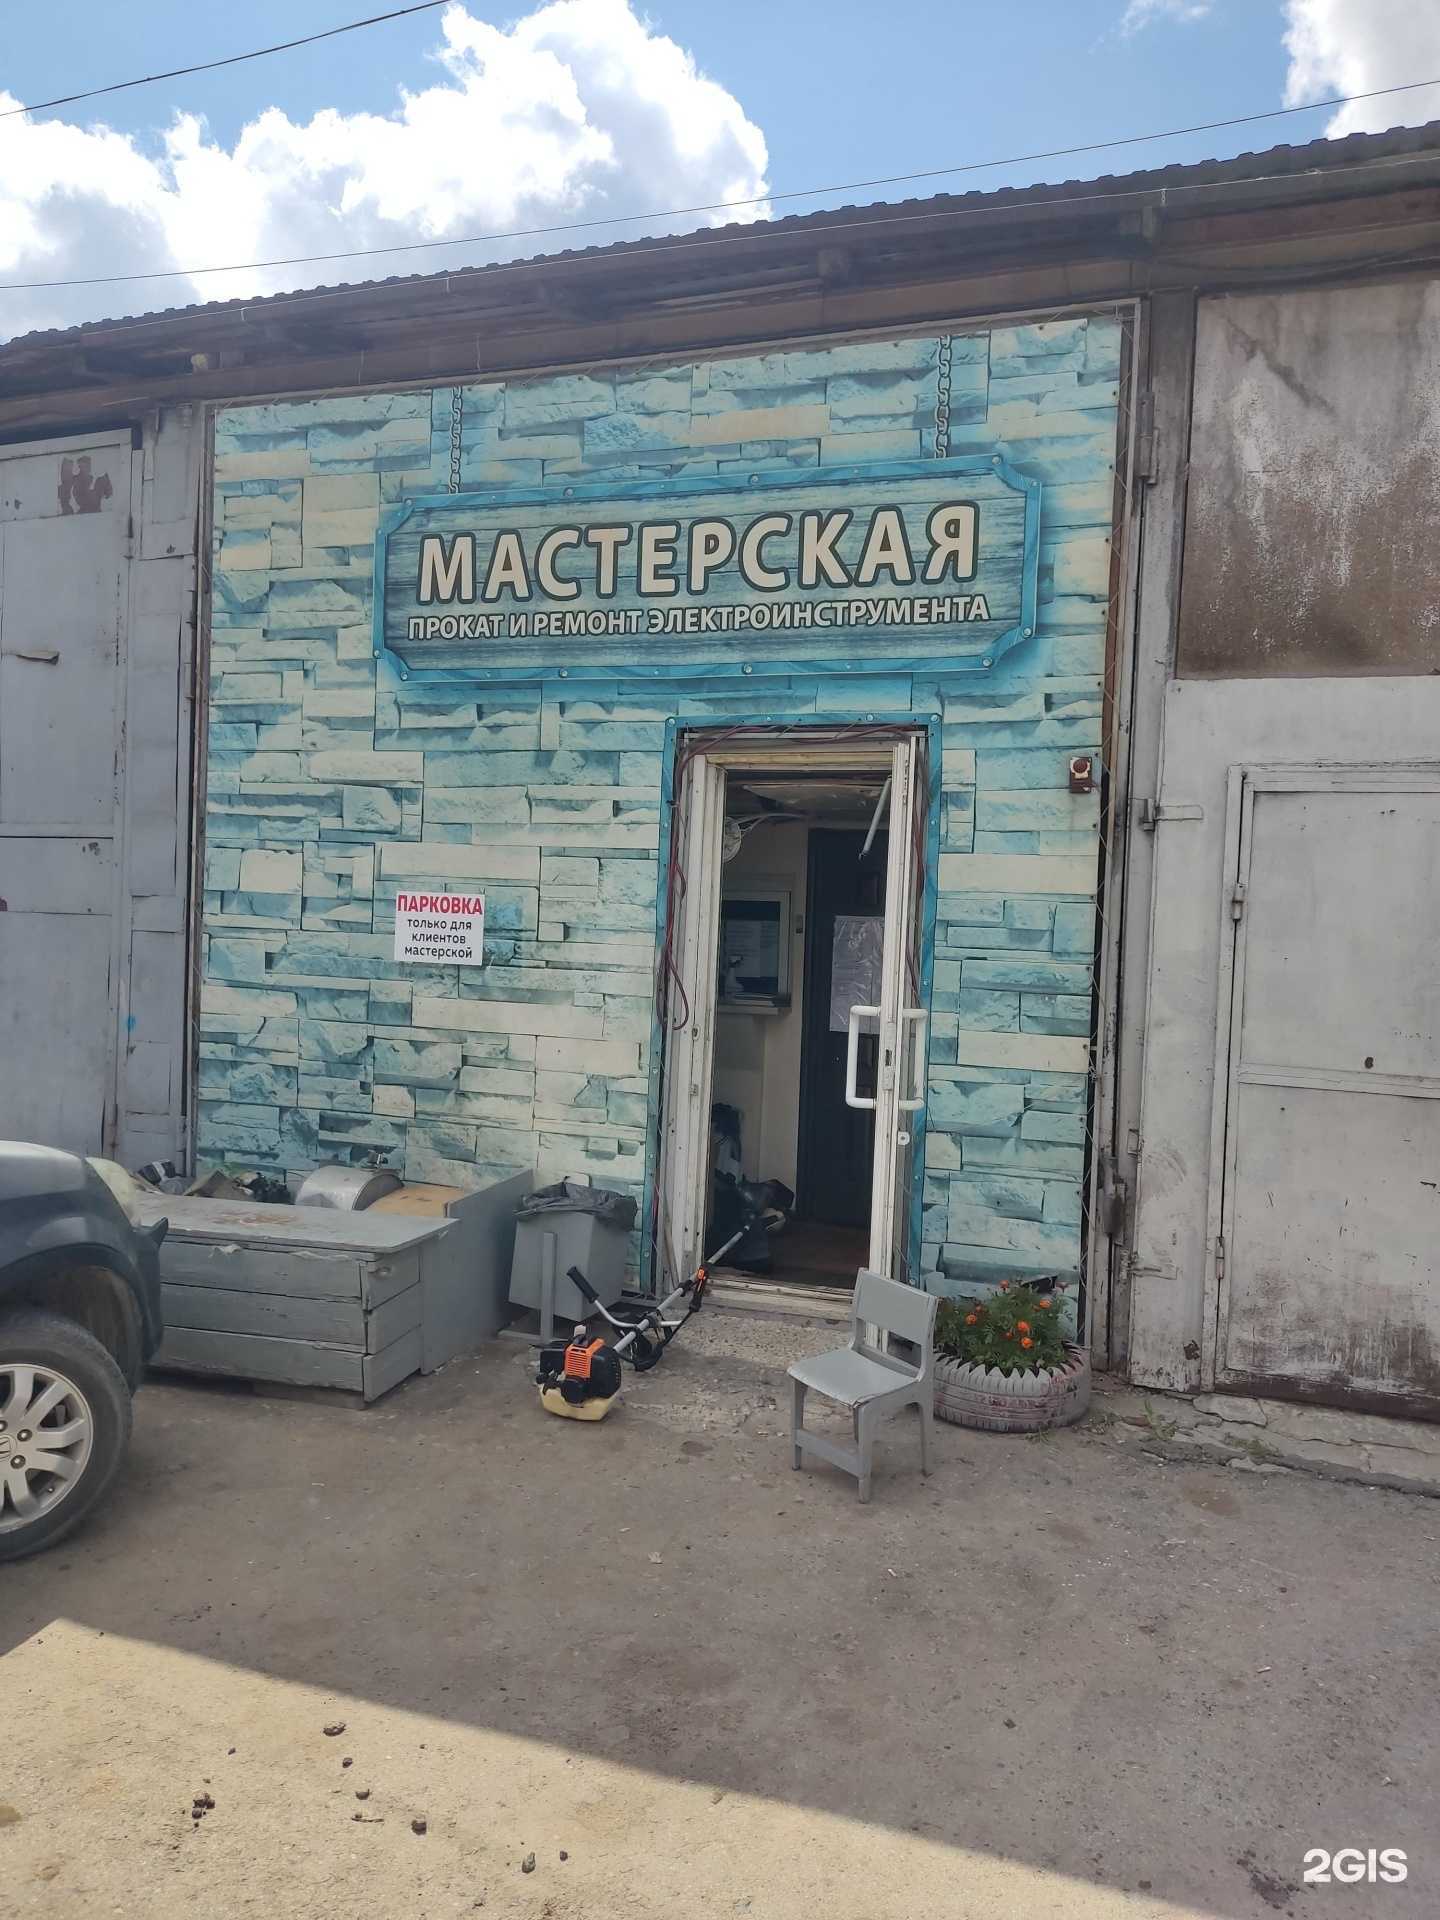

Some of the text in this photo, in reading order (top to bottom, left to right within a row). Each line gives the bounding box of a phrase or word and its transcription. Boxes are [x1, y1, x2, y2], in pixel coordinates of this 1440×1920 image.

[418, 501, 980, 604] МАСТЕРСКАЯ
[408, 595, 990, 640] ПРОКАТ И РЕМОНТ ЭЛЕКТРОИНСТРУМЕНТА
[397, 895, 483, 914] ПАРКОВКА
[407, 919, 472, 932] только для
[412, 933, 466, 944] клиентов
[404, 946, 472, 960] мастерской
